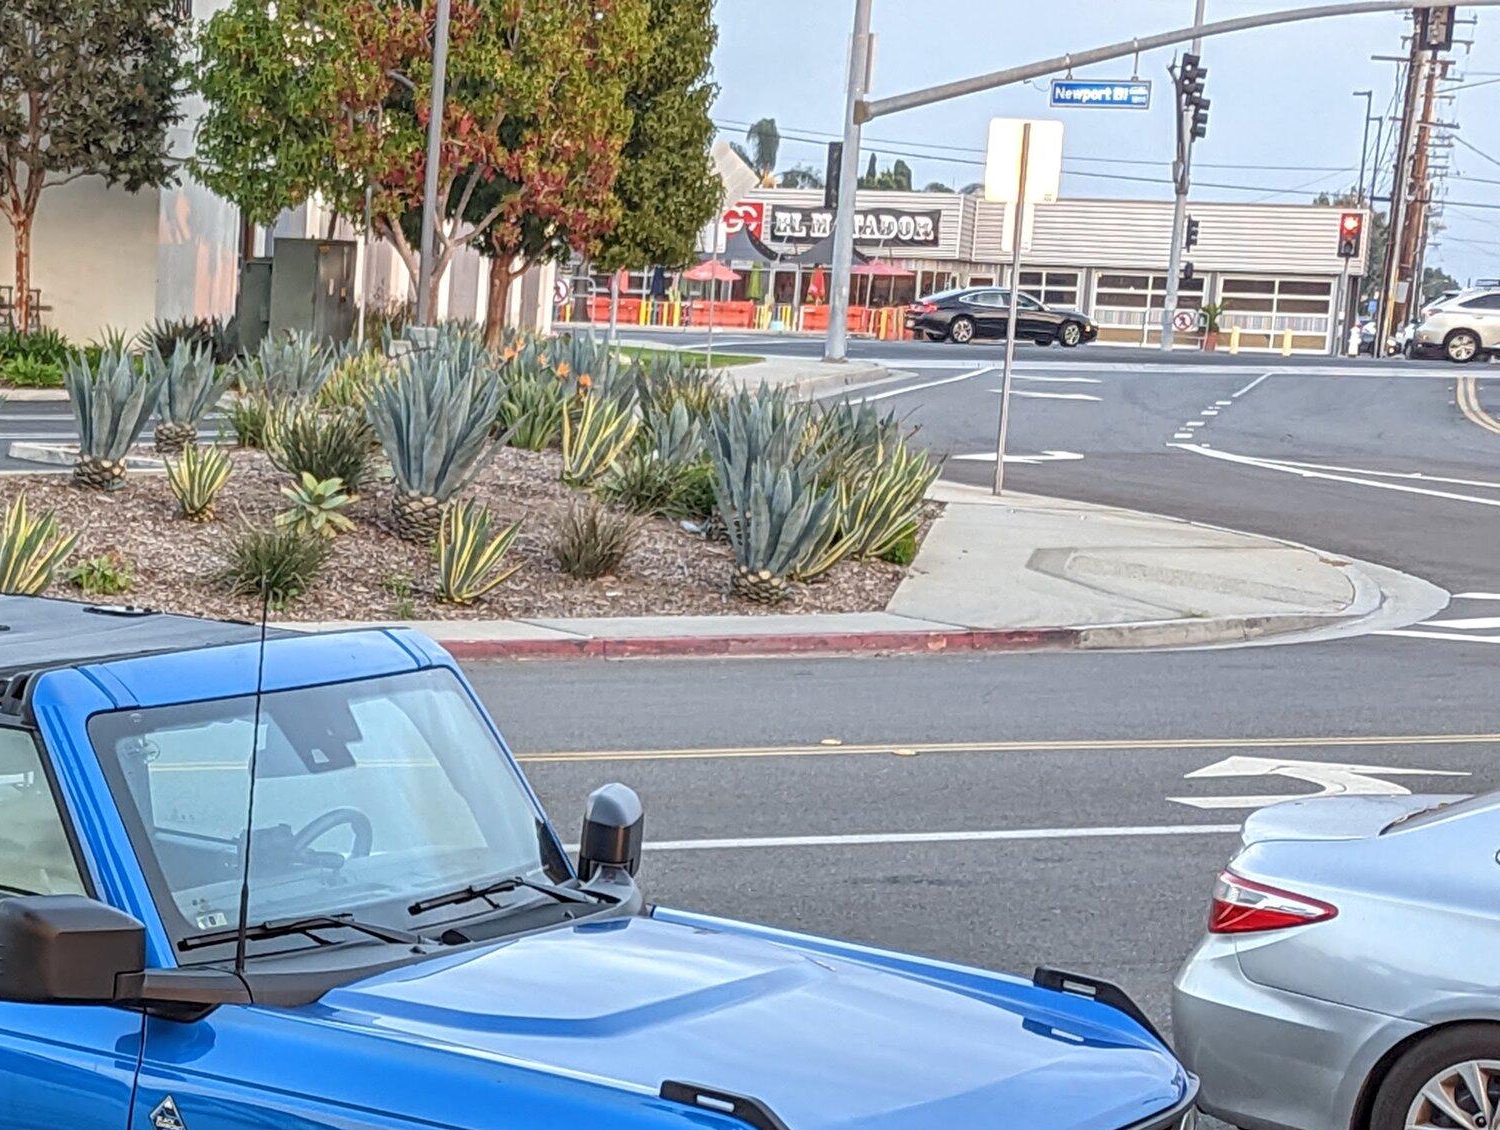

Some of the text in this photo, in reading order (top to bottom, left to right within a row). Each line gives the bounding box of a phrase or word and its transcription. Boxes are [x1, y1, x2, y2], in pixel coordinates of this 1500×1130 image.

[1055, 86, 1112, 103] Newport
[774, 211, 934, 241] EL MTADOR
